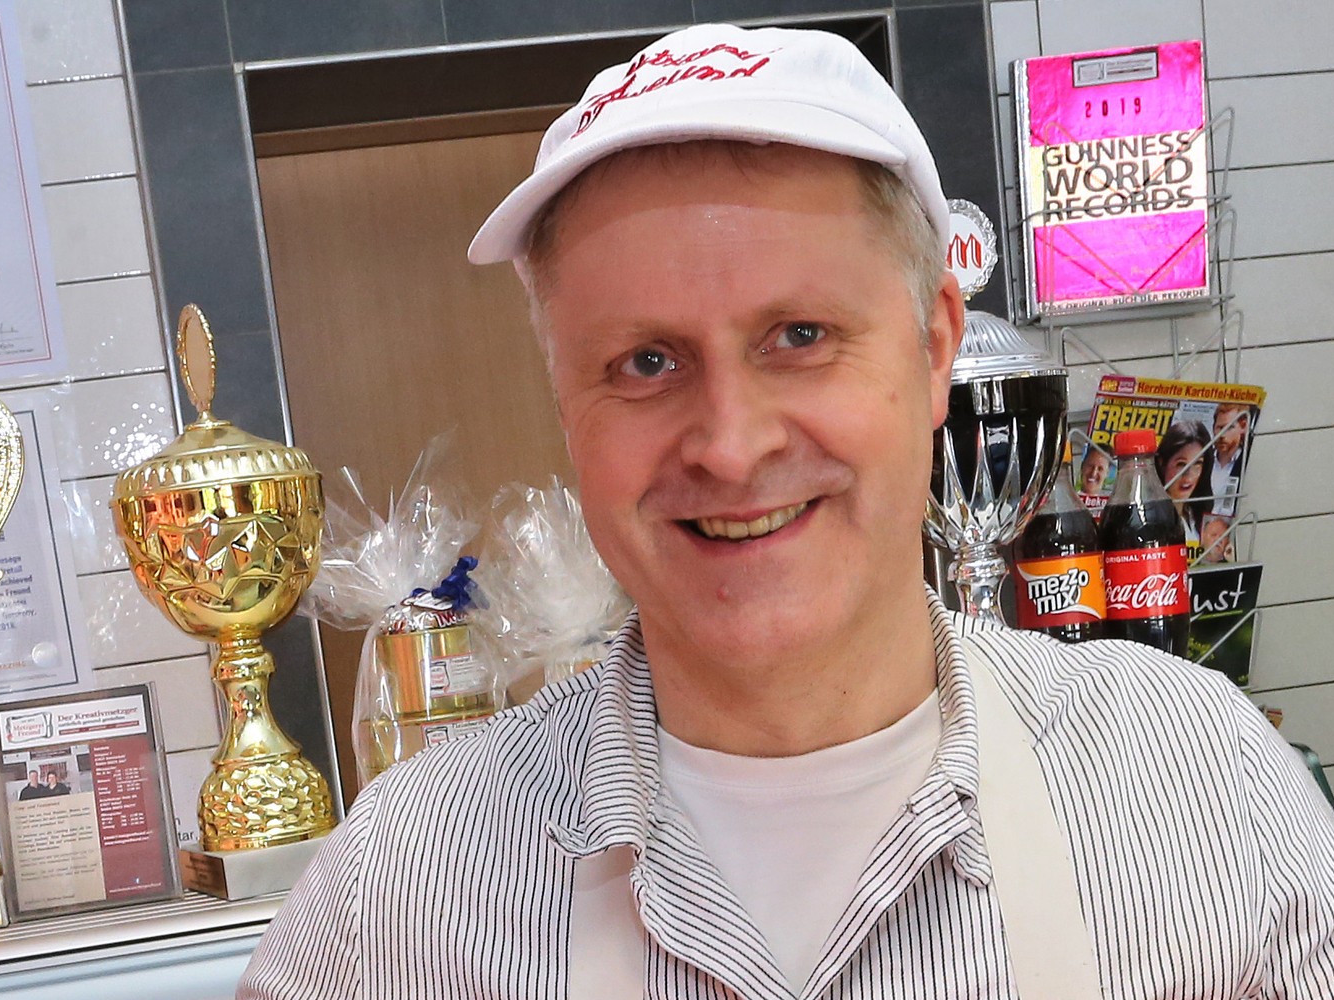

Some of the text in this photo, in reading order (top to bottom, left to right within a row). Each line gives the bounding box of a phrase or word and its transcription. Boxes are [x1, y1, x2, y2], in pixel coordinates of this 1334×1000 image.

[1044, 132, 1191, 166] GUINNESS
[1045, 157, 1193, 196] WORLD
[1045, 185, 1194, 222] RECORDS
[1137, 382, 1257, 400] Herzhafte Kartoffel-Küche
[1095, 405, 1173, 435] FREIZEIT
[1106, 552, 1166, 564] ORIGINAL TASTE
[1028, 568, 1089, 600] mezzo
[1034, 591, 1078, 615] mix
[178, 831, 198, 841] tar.
